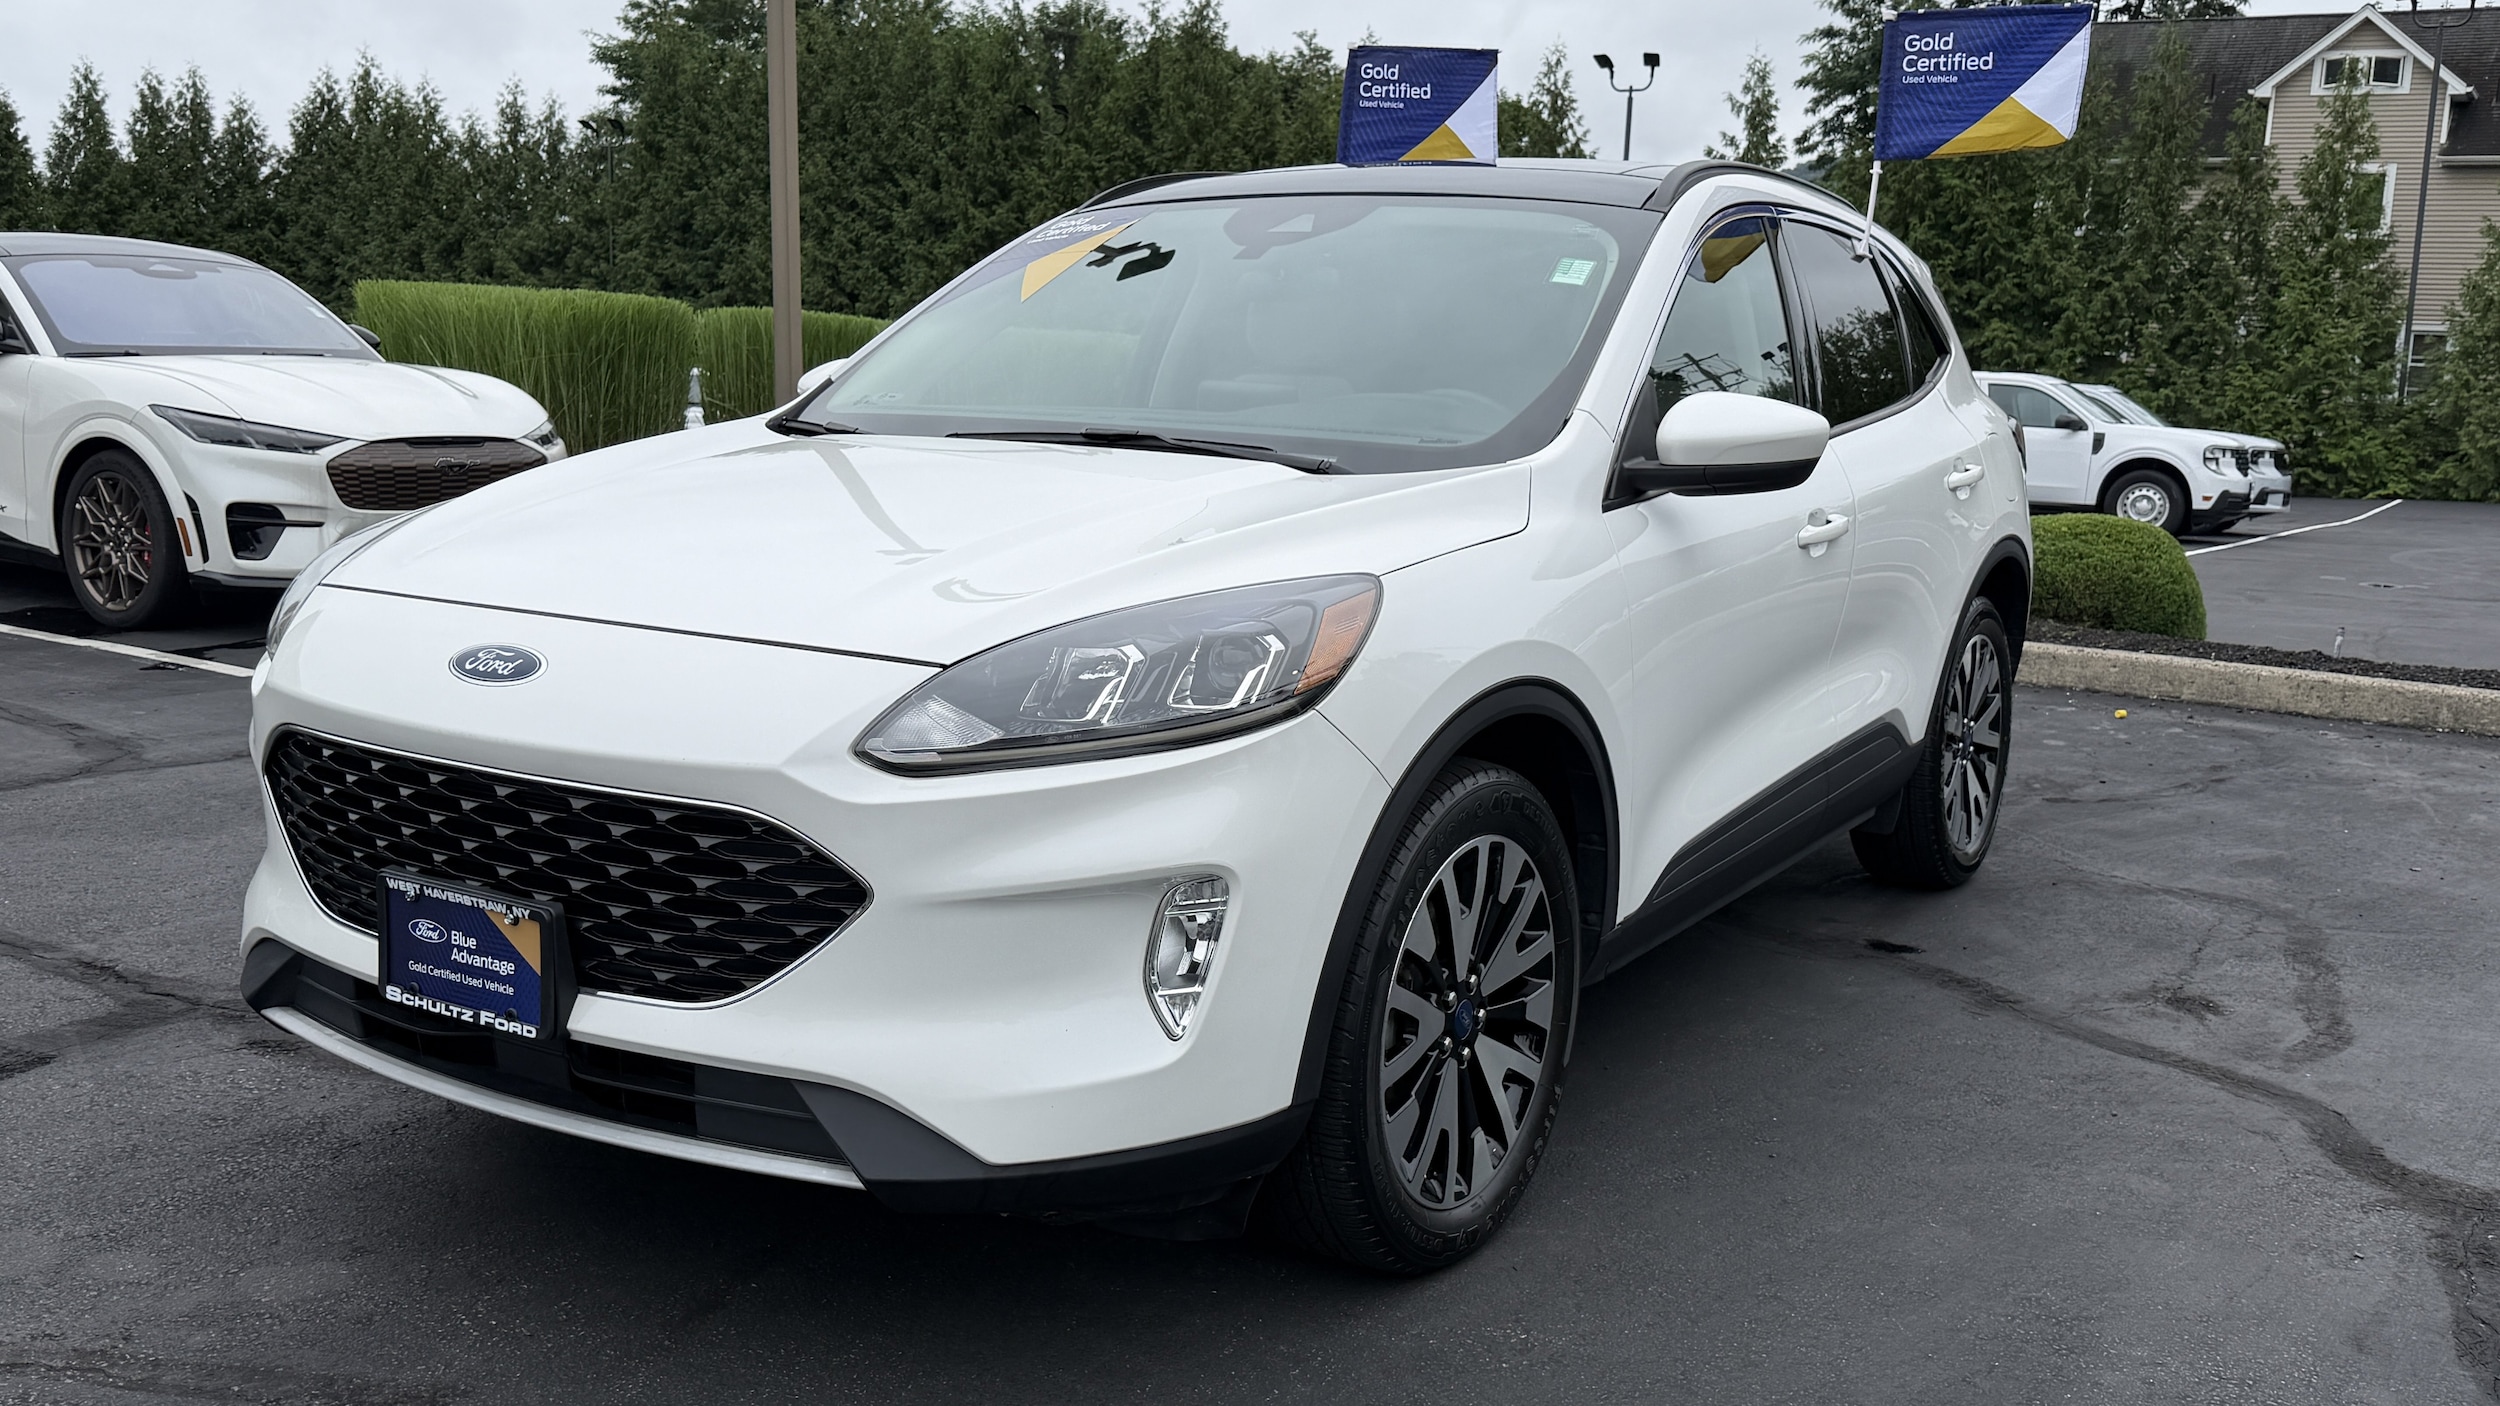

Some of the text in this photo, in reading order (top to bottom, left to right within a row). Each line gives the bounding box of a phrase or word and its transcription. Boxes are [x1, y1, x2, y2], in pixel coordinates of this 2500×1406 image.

[1904, 32, 1955, 52] Gold
[1360, 63, 1399, 80] Gold
[1902, 52, 1994, 73] Certified
[1902, 74, 1958, 84] Used Vehicle
[1359, 81, 1431, 99] Certified
[1359, 99, 1405, 109] Used Vehicle
[465, 648, 524, 676] Ford
[385, 877, 420, 895] WEST
[511, 906, 530, 919] NY
[415, 921, 440, 940] Ford
[451, 930, 477, 949] Blue
[451, 947, 515, 976] Advantage
[408, 960, 515, 996] Gold Certified Used Vehicle
[385, 985, 537, 1039] SCHULTZ FORD
